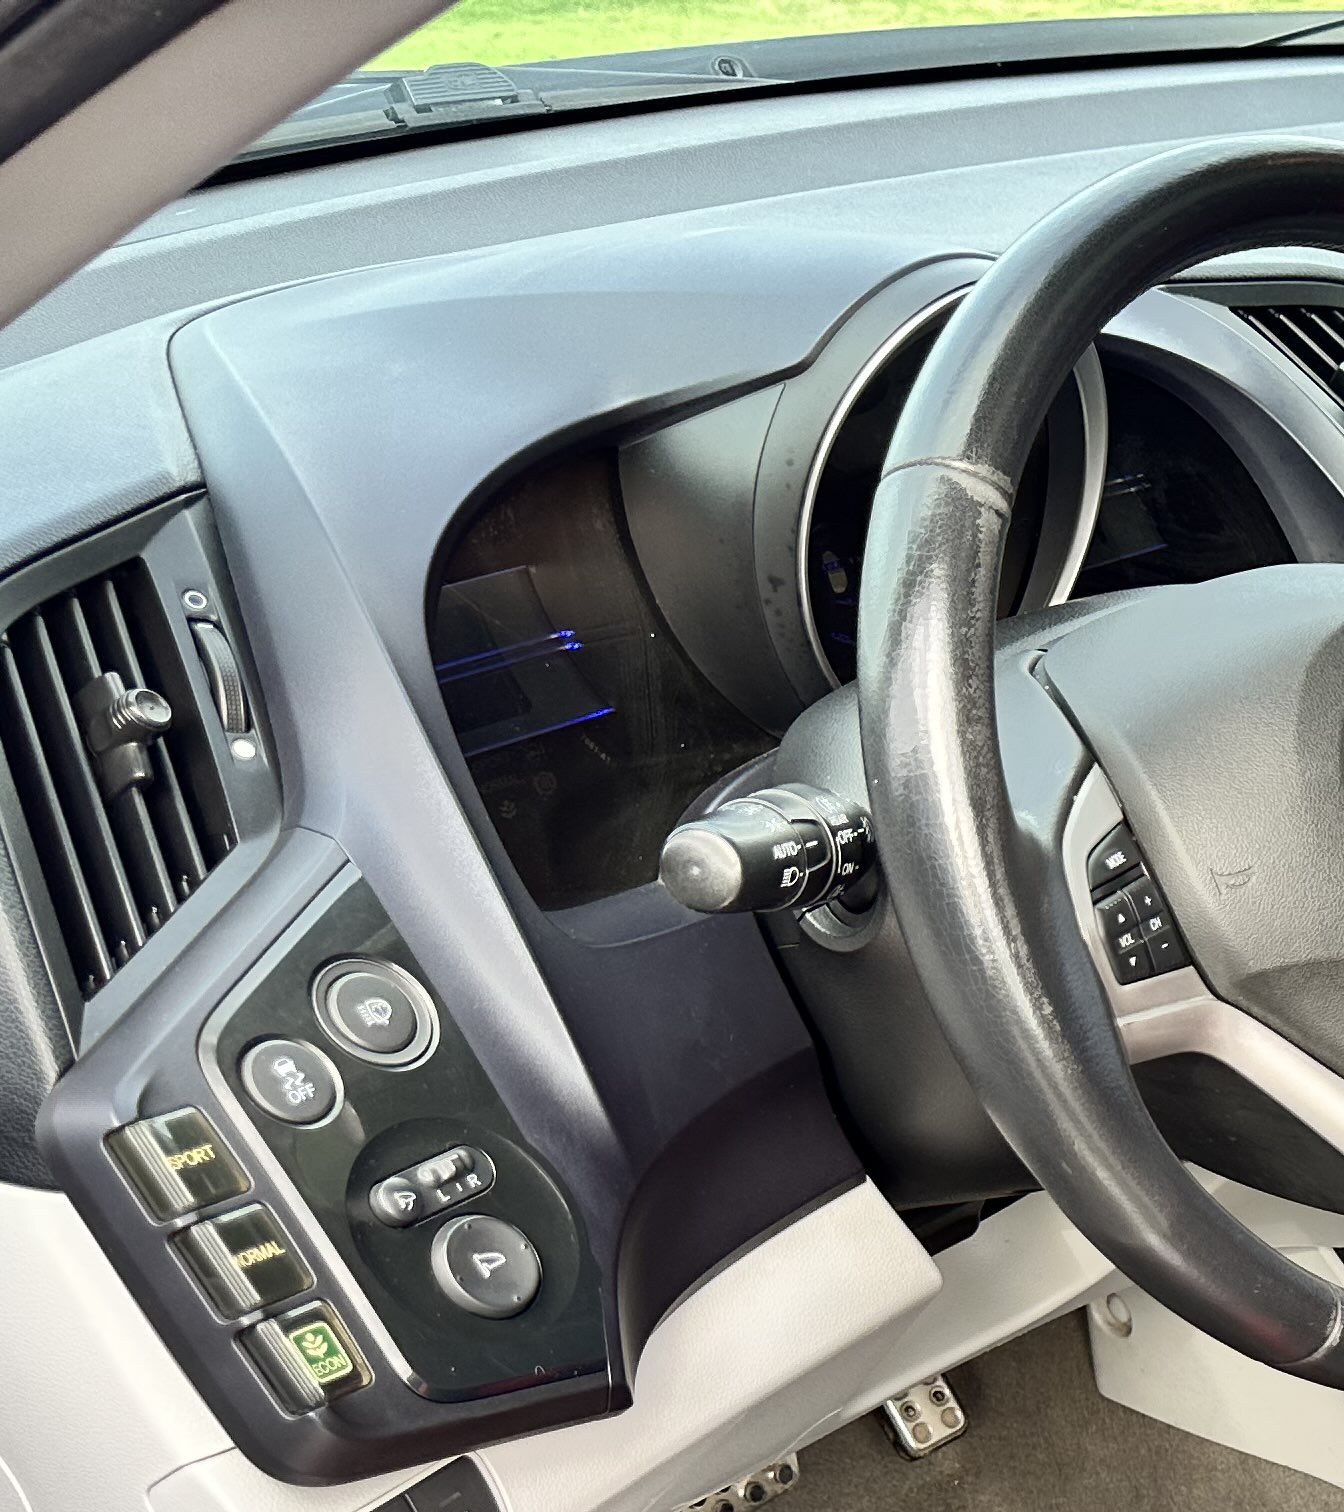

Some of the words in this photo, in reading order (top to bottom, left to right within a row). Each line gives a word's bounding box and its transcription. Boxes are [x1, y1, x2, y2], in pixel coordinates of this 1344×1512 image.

[837, 828, 854, 845] OFF
[772, 840, 798, 860] AUTO
[841, 862, 855, 876] ON
[1105, 851, 1127, 870] MODE
[1149, 916, 1162, 931] CH
[1119, 933, 1135, 948] VOL
[288, 1082, 316, 1106] OFF
[167, 1144, 216, 1170] SPORT
[233, 1240, 286, 1268] NORMAL
[312, 1353, 347, 1377] ECON
